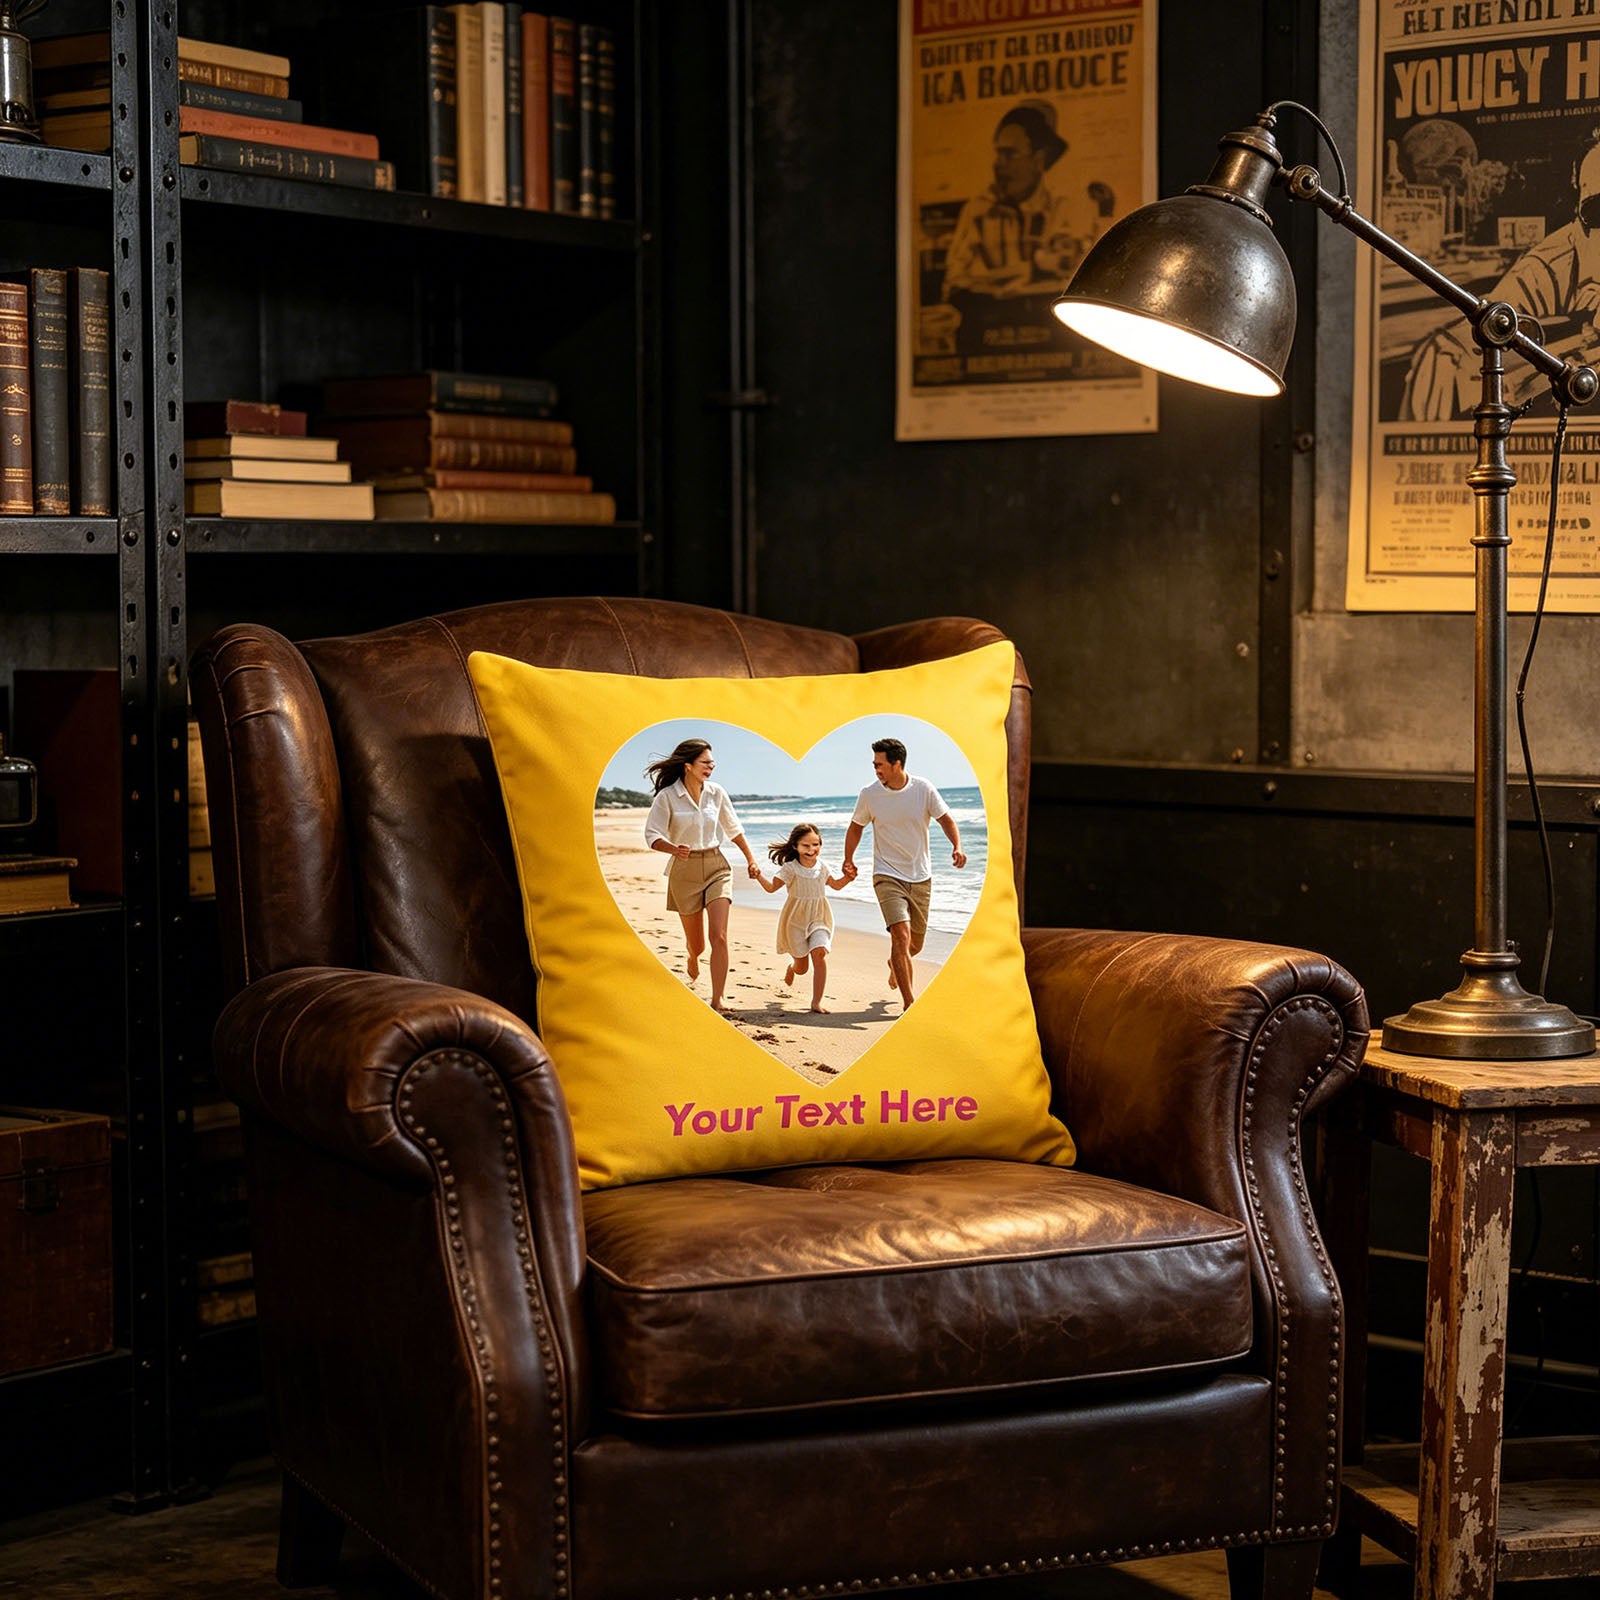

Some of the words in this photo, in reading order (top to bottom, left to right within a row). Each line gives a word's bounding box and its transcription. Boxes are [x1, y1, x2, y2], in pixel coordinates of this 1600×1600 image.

[664, 1102, 763, 1136] Your
[775, 1094, 866, 1129] Text
[880, 1089, 978, 1123] Here
